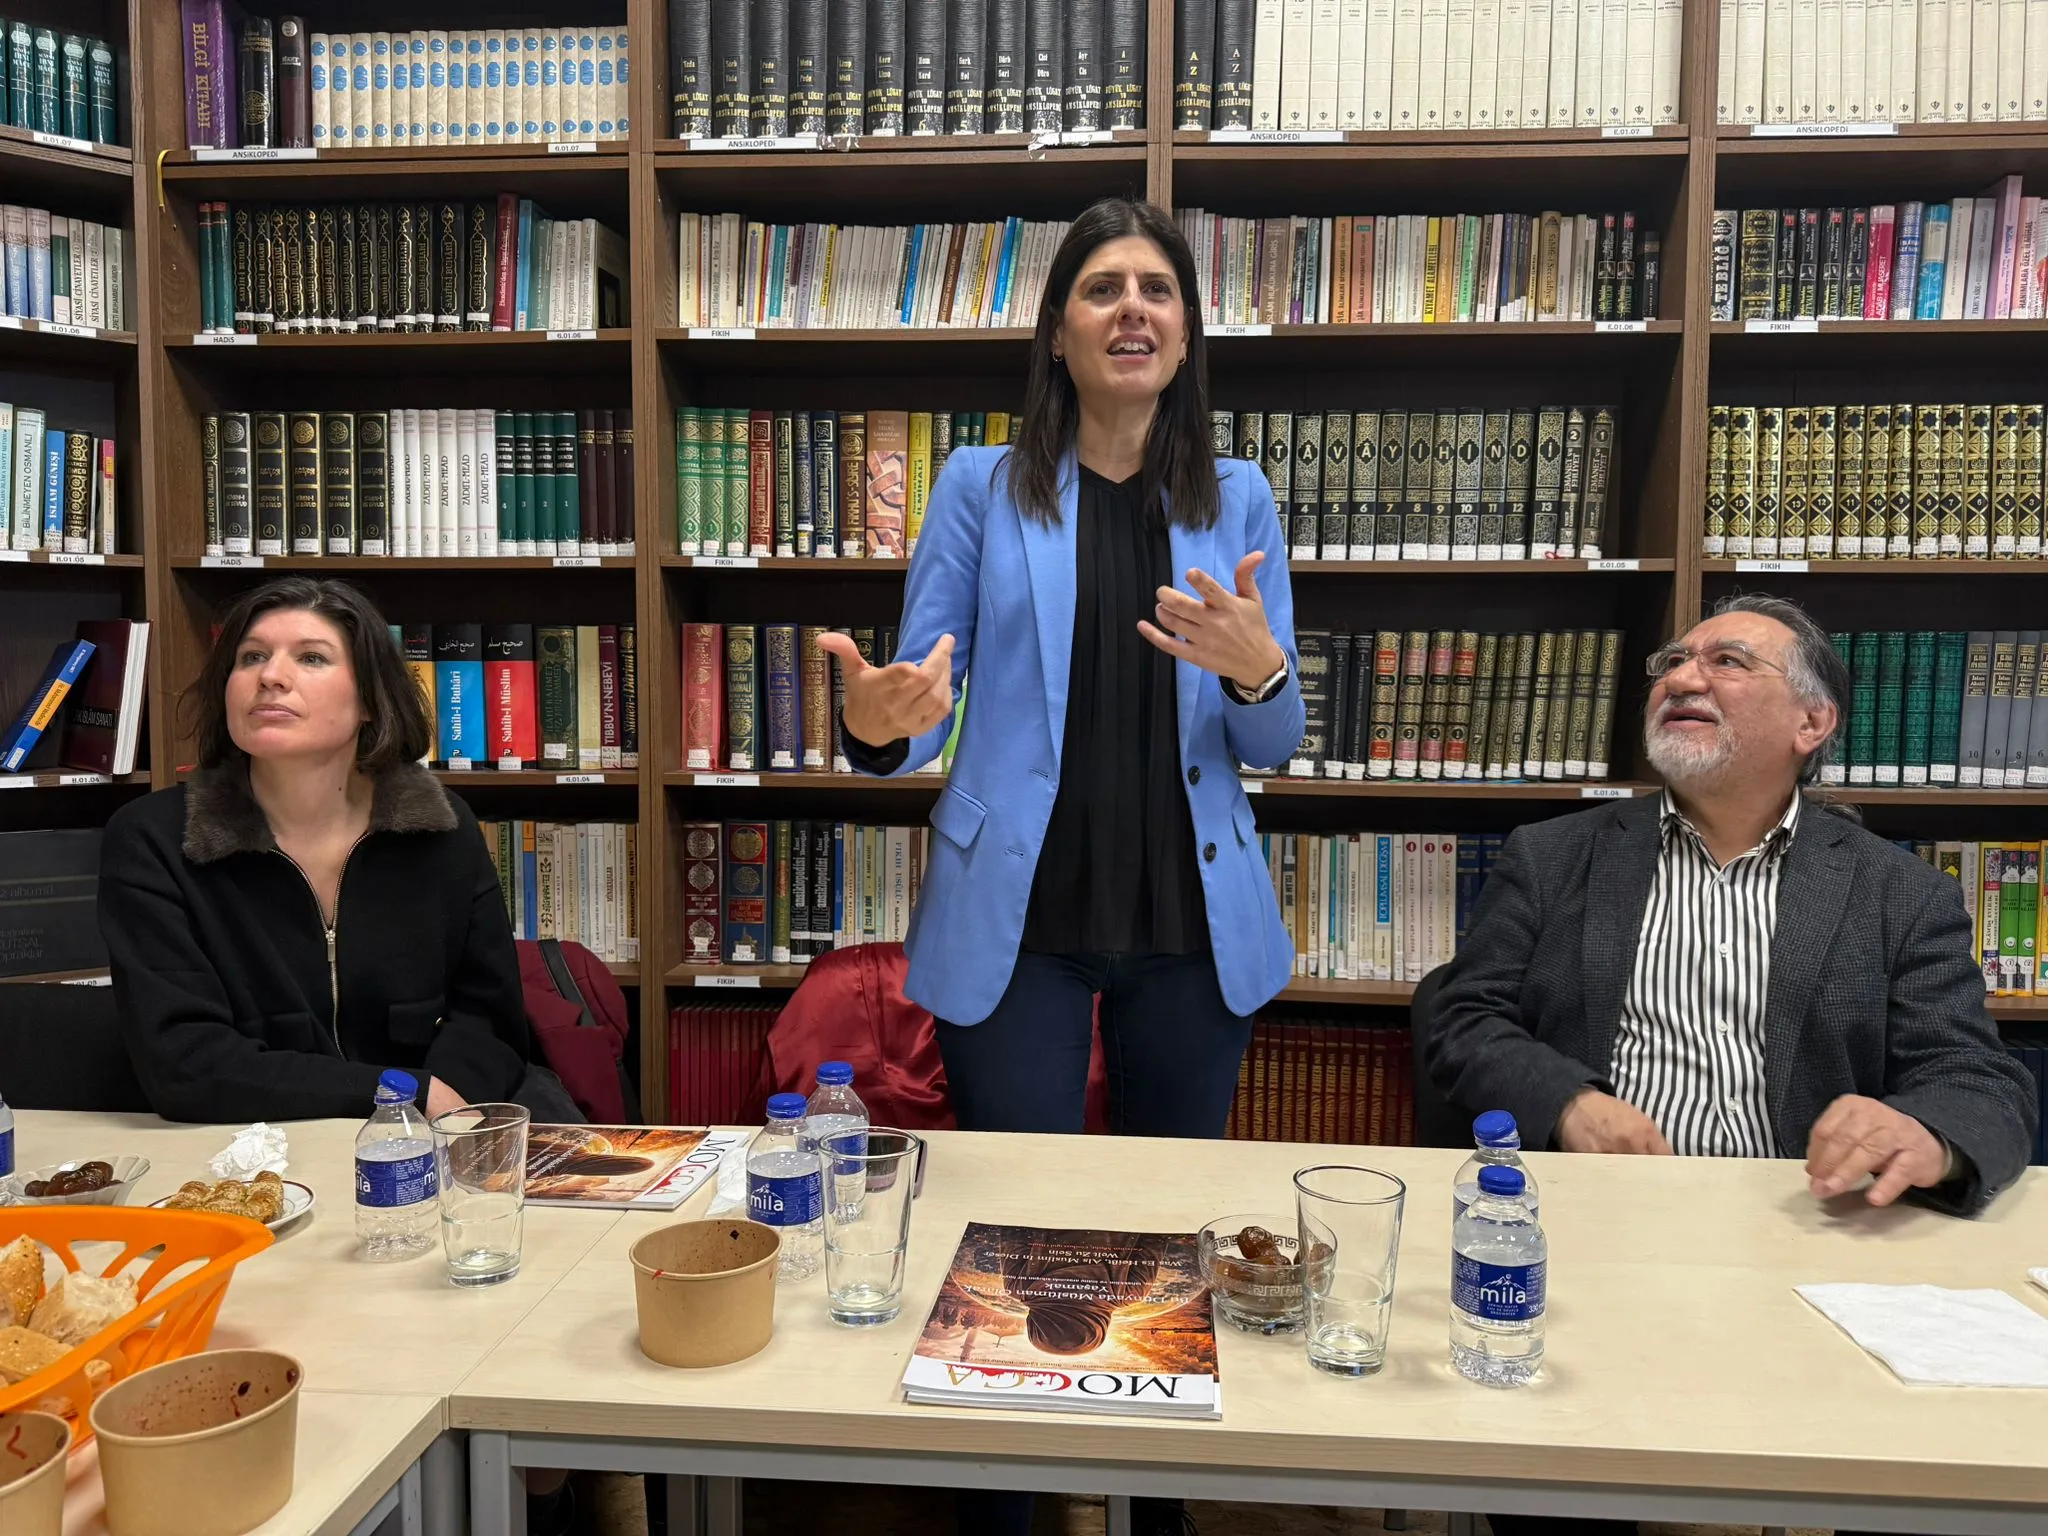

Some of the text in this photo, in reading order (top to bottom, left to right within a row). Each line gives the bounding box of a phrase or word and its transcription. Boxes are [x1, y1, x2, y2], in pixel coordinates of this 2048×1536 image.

[192, 22, 206, 68] BİLGİ
[1189, 51, 1199, 61] A
[1233, 48, 1241, 58] A
[1190, 66, 1198, 76] Z
[1232, 64, 1240, 73] Z
[1250, 133, 1301, 141] ANSİKLOPEDİ
[727, 140, 776, 148] ANSİKLOPEDİ
[232, 150, 278, 159] ANSİKLOPEDİ
[1714, 244, 1730, 302] TEBLİĞ
[1424, 286, 1435, 315] KIYAMET
[213, 335, 235, 343] HADİS
[1570, 431, 1578, 440] 2
[1246, 444, 1253, 457] E
[1275, 445, 1283, 458] T
[1333, 446, 1342, 460] V
[1388, 446, 1398, 458] Y
[1439, 446, 1449, 460] H
[1491, 445, 1501, 458] N
[1517, 445, 1527, 458] D
[1564, 456, 1573, 493] EMANET
[1590, 456, 1600, 494] EMANET
[23, 433, 33, 528] BİLİNMEYEN OSMANLI
[48, 451, 60, 518] İSLAM GÜNEŞİ
[1275, 502, 1552, 514] 3 4 5 6 7 8 9 10 11 12 13
[220, 557, 242, 566] HADİS
[501, 668, 511, 705] Müslim
[1968, 751, 1979, 759] 10
[1994, 749, 2000, 757] 9
[2016, 751, 2022, 760] 8
[2038, 750, 2044, 758] 6
[791, 857, 808, 907] ansiklopedisi
[811, 858, 830, 907] ansiklopedisi
[1377, 875, 1389, 920] TOPLUMSAL
[716, 977, 735, 985] FIKIH
[751, 1195, 784, 1212] mila
[983, 1250, 1019, 1261] Dieser
[1022, 1254, 1033, 1262] In
[1037, 1254, 1079, 1264] Muslim
[1049, 1249, 1118, 1260] Welt Zu Sein
[1083, 1257, 1101, 1265] Als
[1159, 1259, 1182, 1267] Was
[1044, 1282, 1109, 1293] Yaşamak
[963, 1283, 1190, 1305] Bu Dünyada Müslüman Olarak
[1480, 1286, 1526, 1304] mila
[1528, 1306, 1538, 1314] 330
[943, 1363, 1184, 1399] MOCCA
